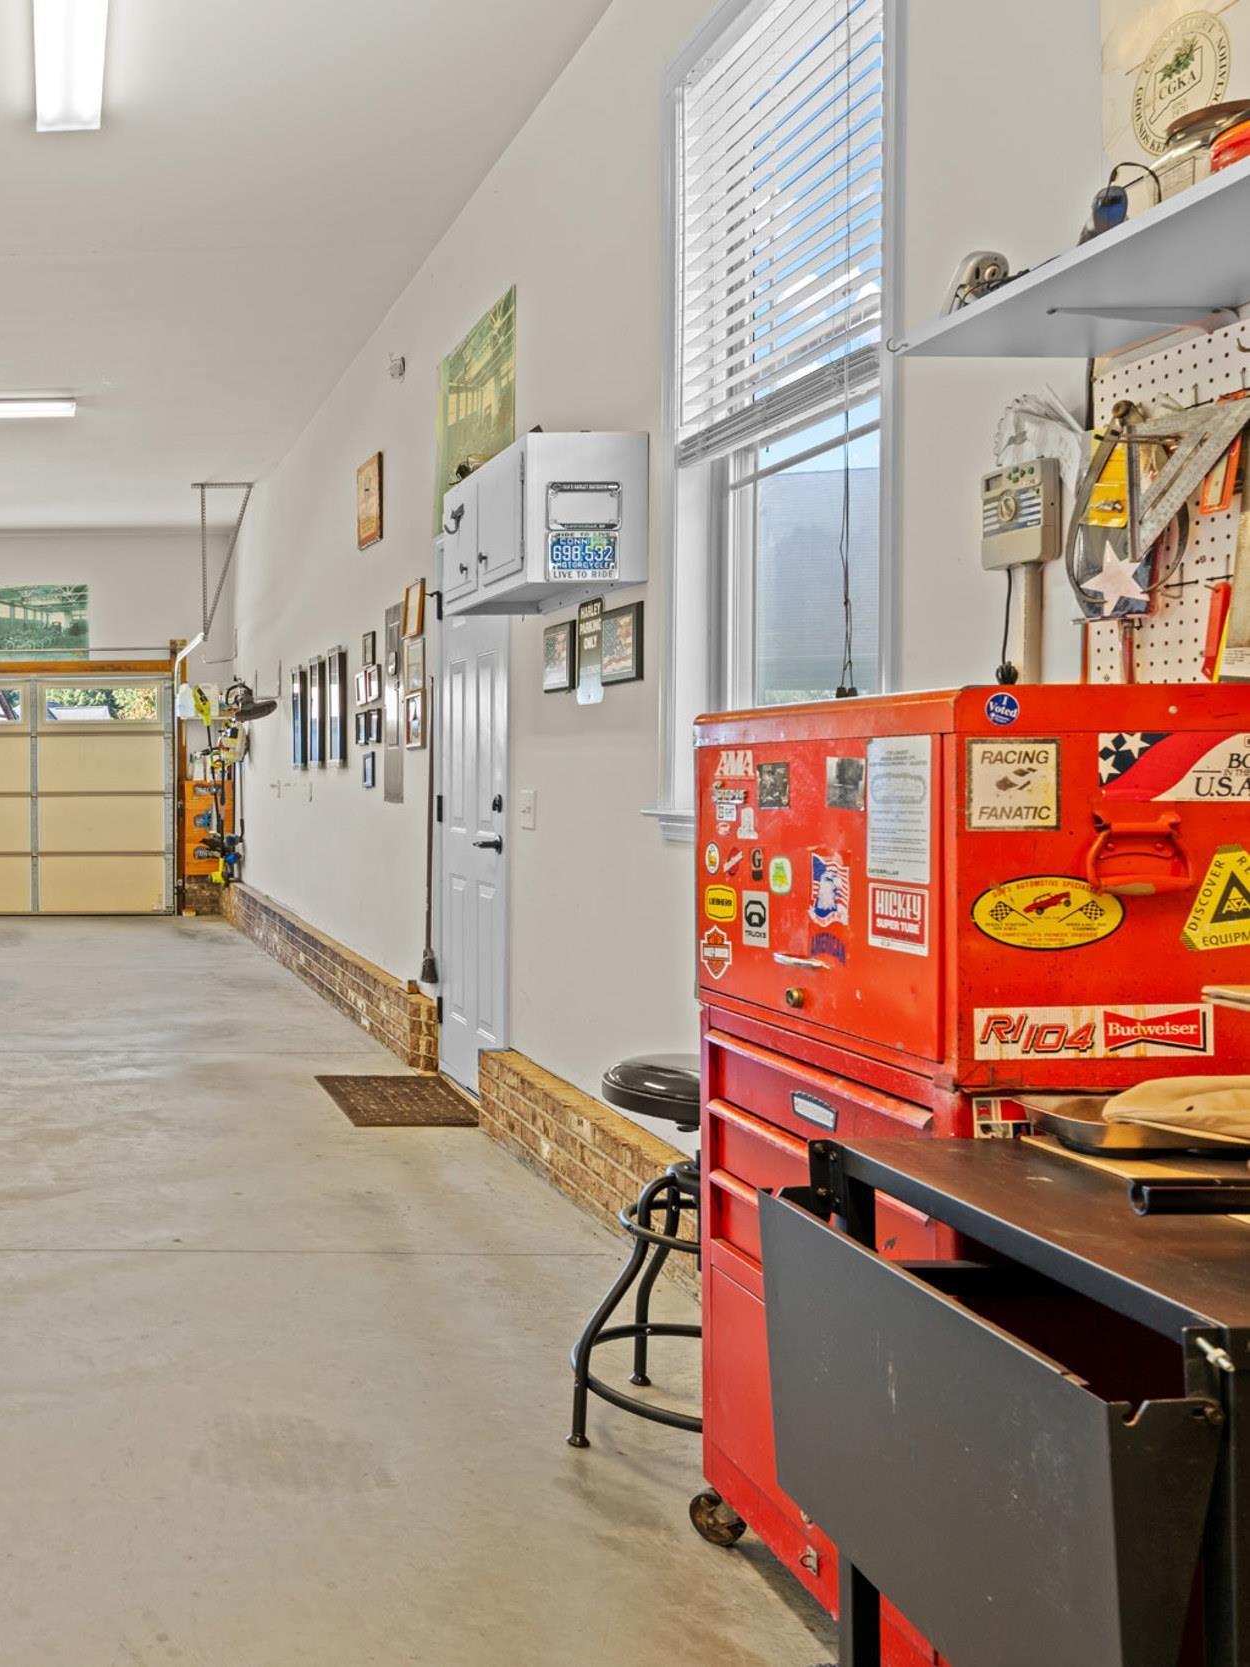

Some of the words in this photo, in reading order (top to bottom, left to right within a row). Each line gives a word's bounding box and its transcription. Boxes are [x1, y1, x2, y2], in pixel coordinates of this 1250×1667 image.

[1159, 71, 1197, 100] CGKA
[559, 537, 588, 545] CONN
[553, 570, 573, 579] LIVE
[576, 570, 587, 578] TO
[591, 570, 613, 578] RIDE
[989, 701, 1017, 718] Voted
[714, 750, 754, 777] AMA
[980, 749, 1050, 765] RACING
[978, 805, 1051, 821] FANATIC
[1188, 860, 1225, 932] DISCOVER
[875, 889, 921, 922] HICKEY
[745, 929, 767, 939] TRUCKS
[1107, 1021, 1199, 1037] Budweiser
